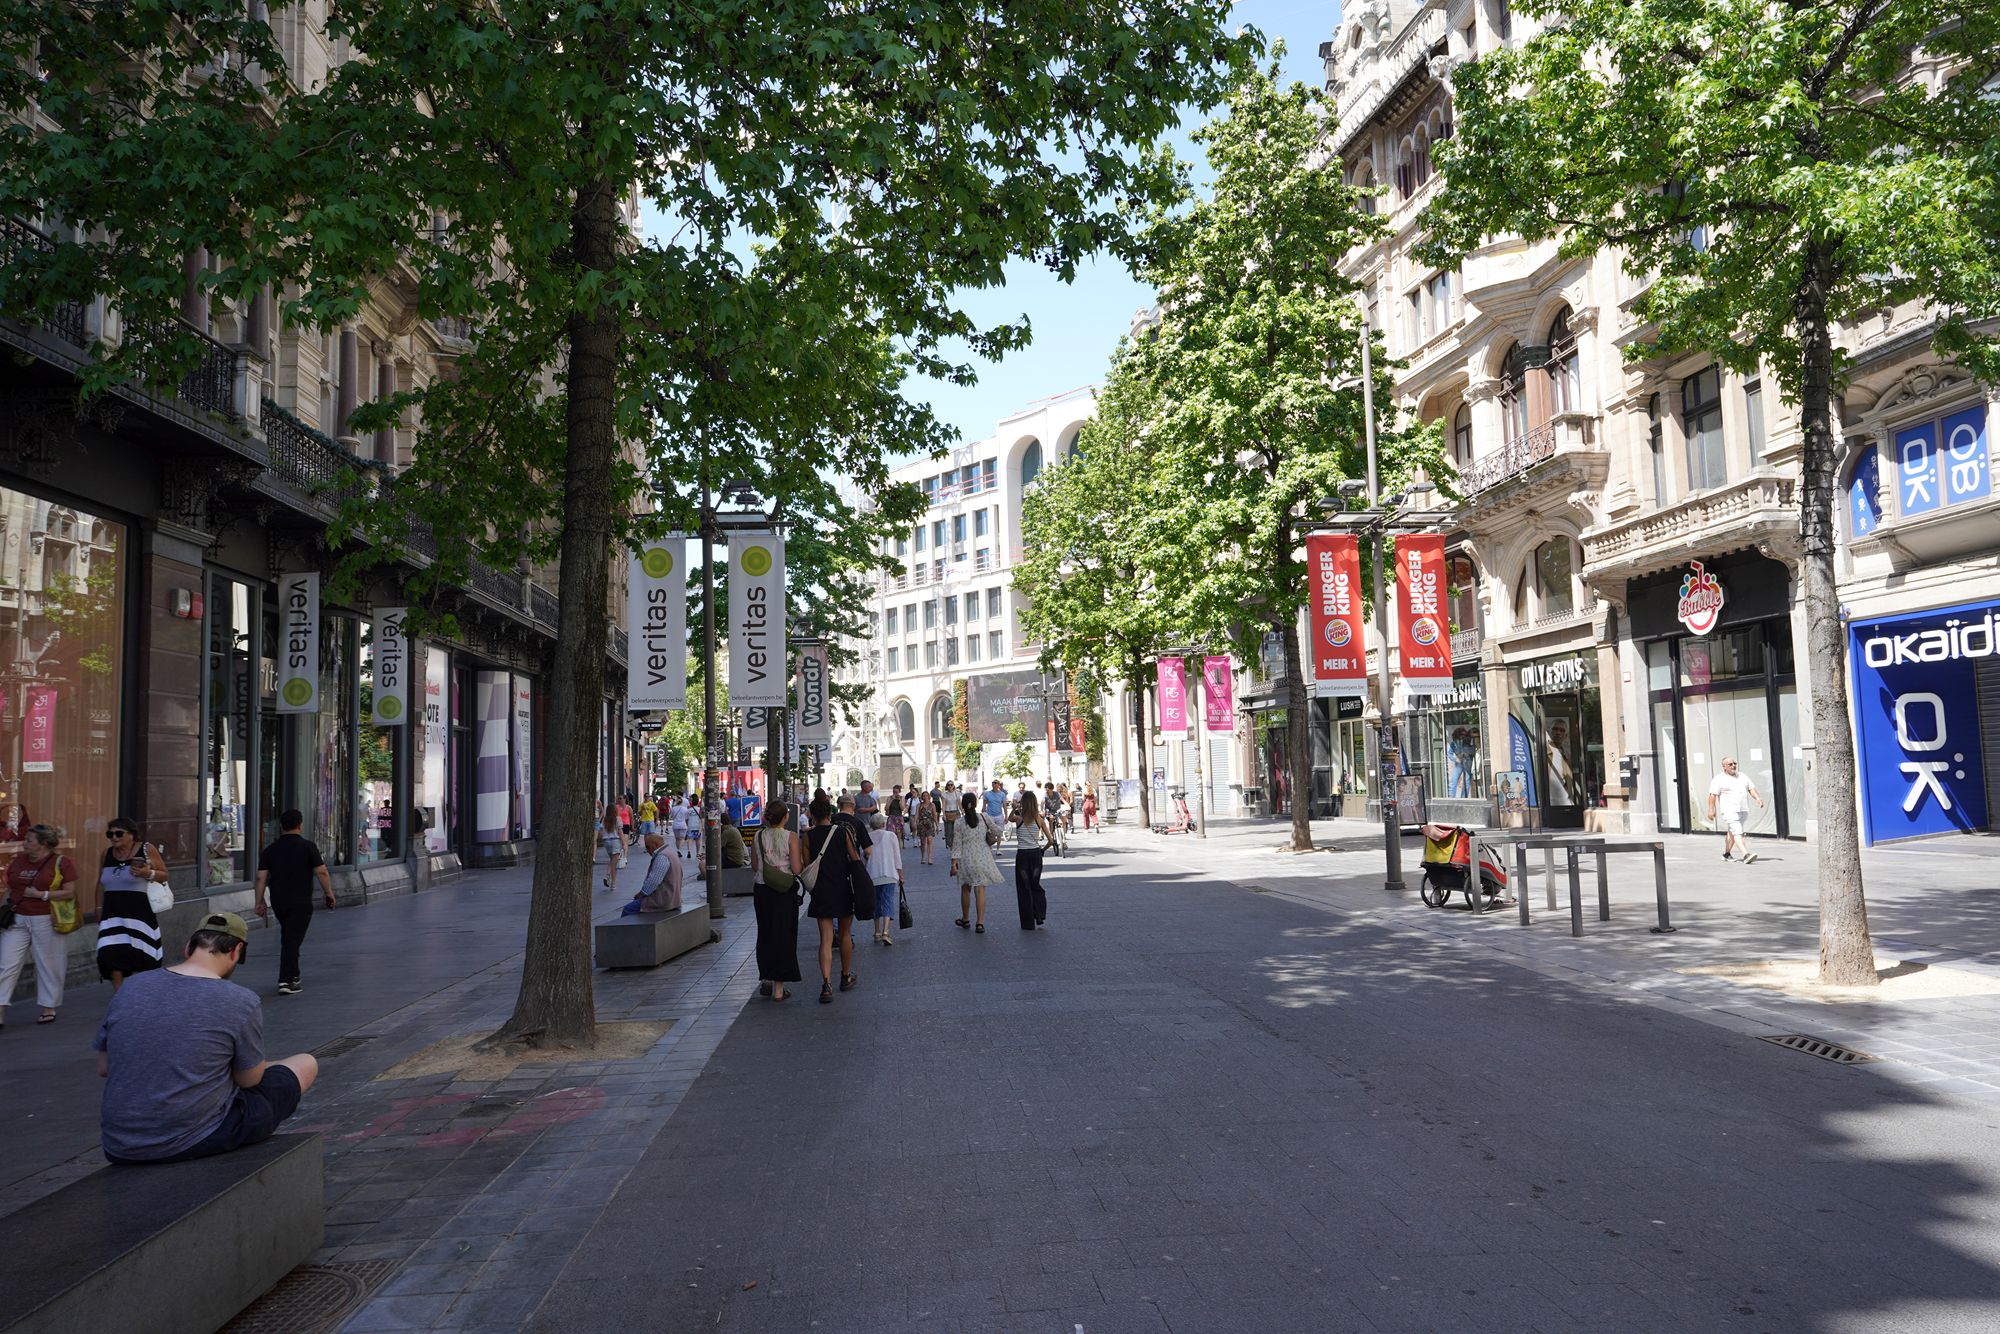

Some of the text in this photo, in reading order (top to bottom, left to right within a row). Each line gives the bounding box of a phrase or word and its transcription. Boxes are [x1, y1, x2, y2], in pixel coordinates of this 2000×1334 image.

[1320, 551, 1337, 616] BURGER
[1334, 573, 1351, 616] KING
[1408, 550, 1424, 615] BURGER
[1422, 573, 1438, 615] KING
[1680, 589, 1721, 618] Bubble
[289, 579, 312, 668] veritas
[742, 586, 767, 684] veritas
[1328, 623, 1348, 635] BURGER
[1329, 630, 1348, 640] KING
[1416, 628, 1435, 639] KING
[642, 588, 667, 686] veritas
[382, 612, 402, 688] veritas
[1410, 656, 1444, 668] MEIR 1
[1323, 658, 1357, 670] MEIR 1
[731, 694, 783, 702] beleefantwerpen.be
[803, 656, 822, 727] wondr
[990, 698, 1012, 706] MAAK
[426, 703, 439, 723] OTE
[992, 706, 1007, 714] MET
[1019, 704, 1040, 712] TEAM
[1340, 701, 1354, 711] LUSH
[426, 724, 446, 745] ENING
[1057, 704, 1068, 744] SLAETS
